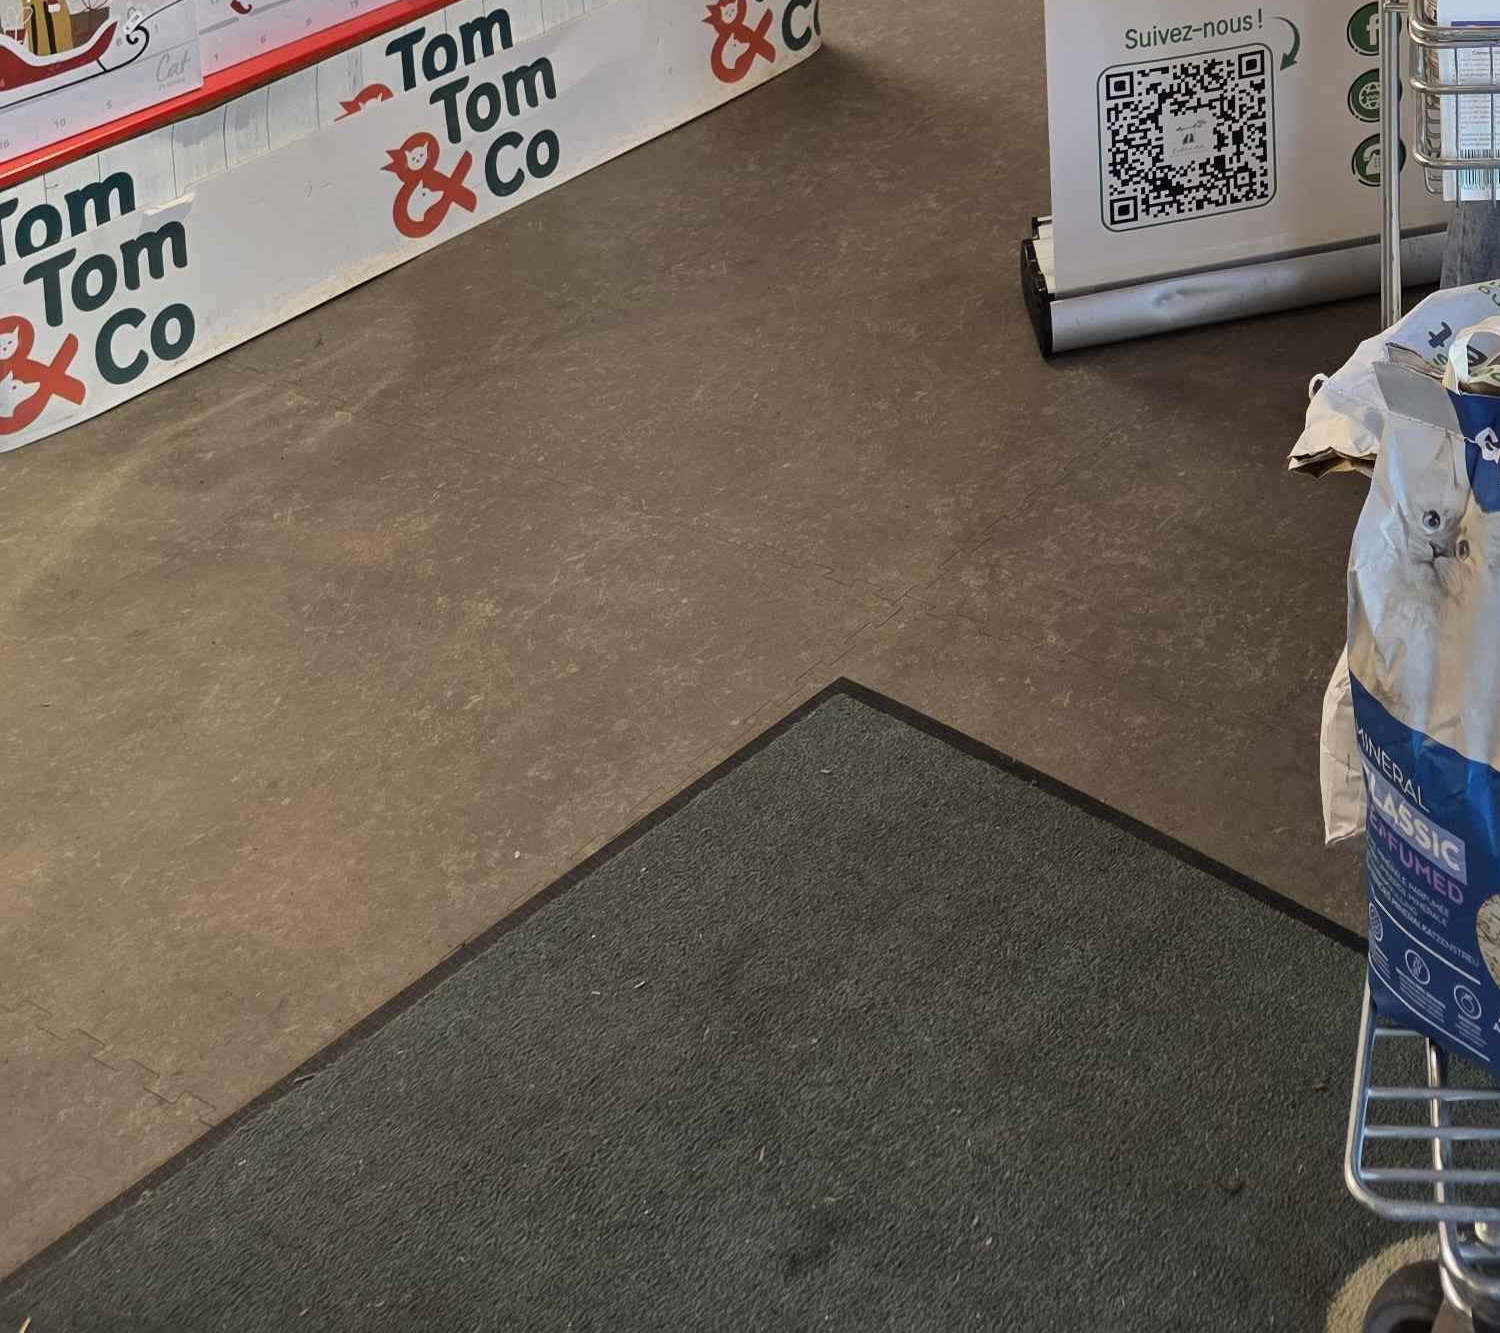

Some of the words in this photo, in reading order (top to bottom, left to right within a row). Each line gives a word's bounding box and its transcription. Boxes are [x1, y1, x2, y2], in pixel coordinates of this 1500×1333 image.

[155, 49, 192, 83] Cat
[386, 8, 515, 92] Tom
[1125, 14, 1254, 50] Suivez-nous
[1257, 8, 1264, 29] !
[430, 56, 557, 144] Tom
[380, 131, 478, 239] &
[484, 129, 560, 198] Co
[22, 220, 188, 327] Tom
[95, 302, 195, 386] Co
[1357, 728, 1432, 814] MINERAL
[1362, 763, 1461, 872] LASSIC
